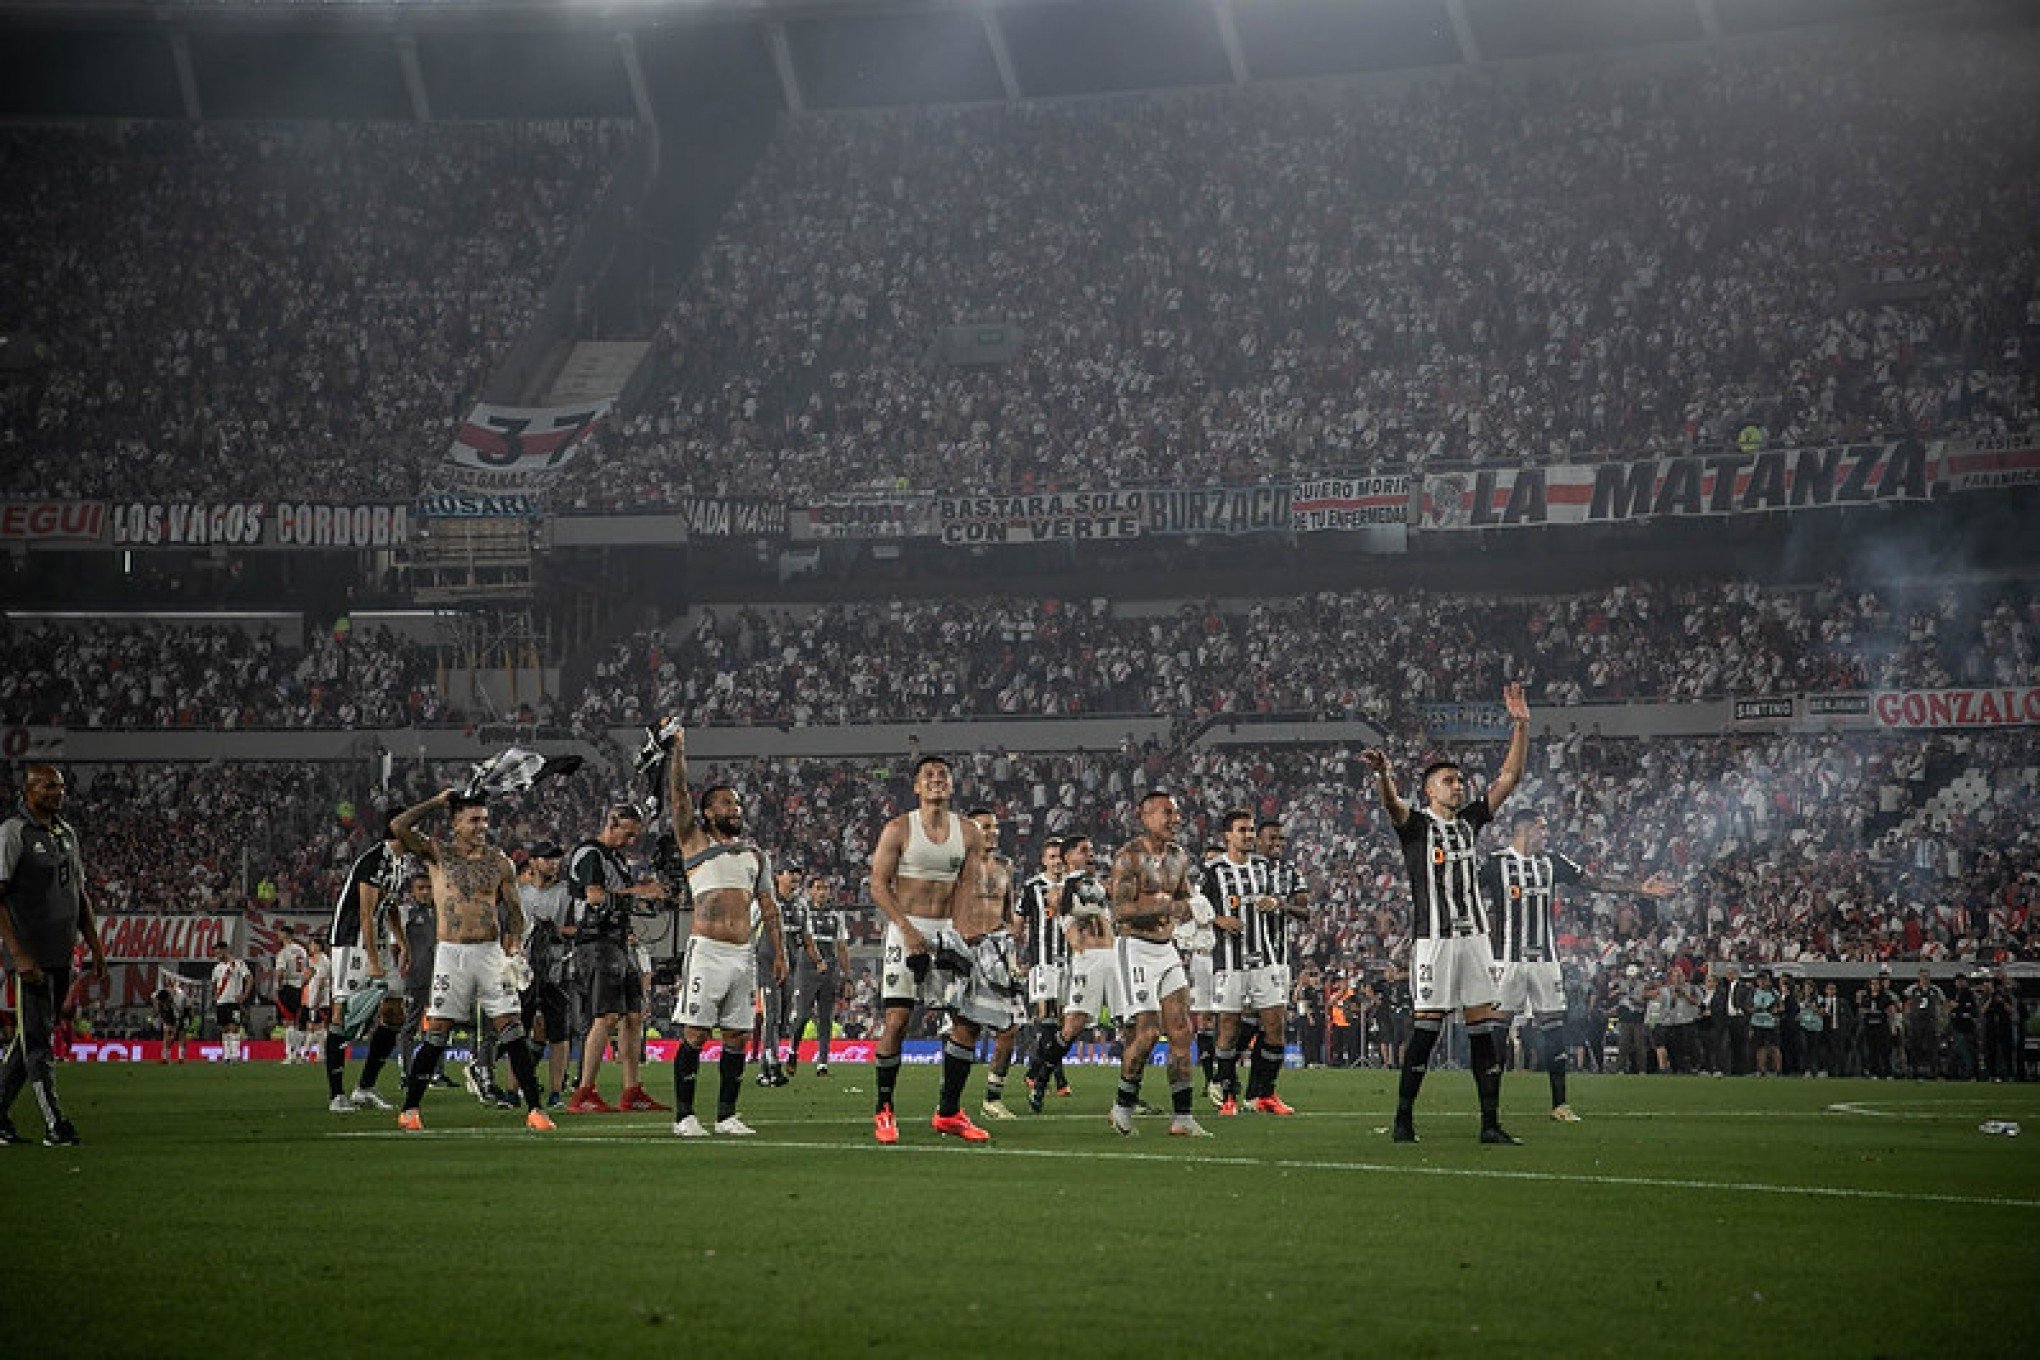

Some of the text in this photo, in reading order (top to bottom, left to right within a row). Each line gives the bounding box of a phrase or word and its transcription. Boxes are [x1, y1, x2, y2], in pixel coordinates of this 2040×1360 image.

[1471, 440, 1927, 526] LA MATANZA
[2, 503, 103, 537] EGUI
[114, 503, 264, 544] LOS VAGOS
[278, 502, 408, 546] CORDOBA
[941, 491, 1142, 519] BASTARA SOLO
[1148, 487, 1292, 534] BURZACO
[943, 521, 1006, 542] CON
[1030, 517, 1139, 540] VERTE
[101, 917, 223, 958] CABALLITO
[691, 976, 702, 994] 5
